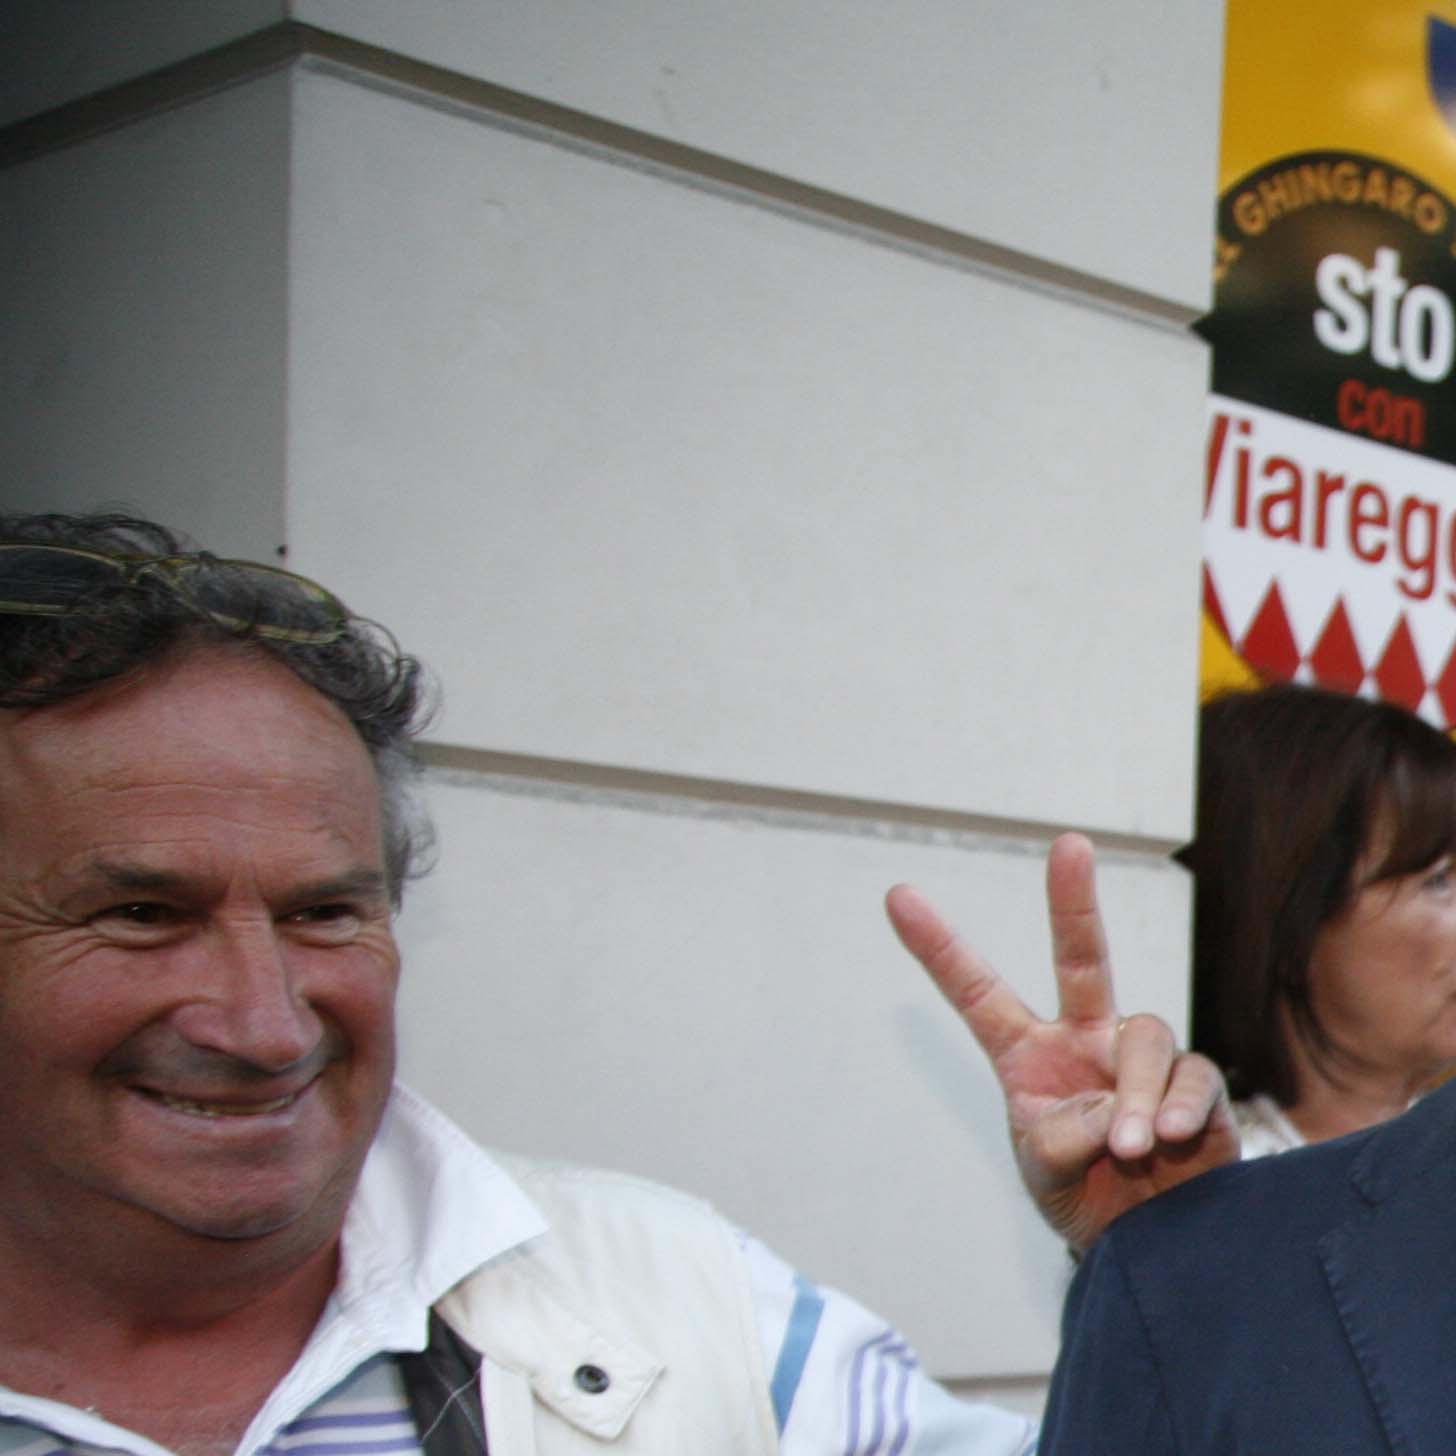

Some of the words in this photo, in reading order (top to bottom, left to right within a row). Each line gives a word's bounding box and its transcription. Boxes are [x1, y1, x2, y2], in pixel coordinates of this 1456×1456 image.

[1231, 159, 1448, 236] GHINGARO
[1313, 245, 1456, 384] sto
[1337, 378, 1425, 448] con
